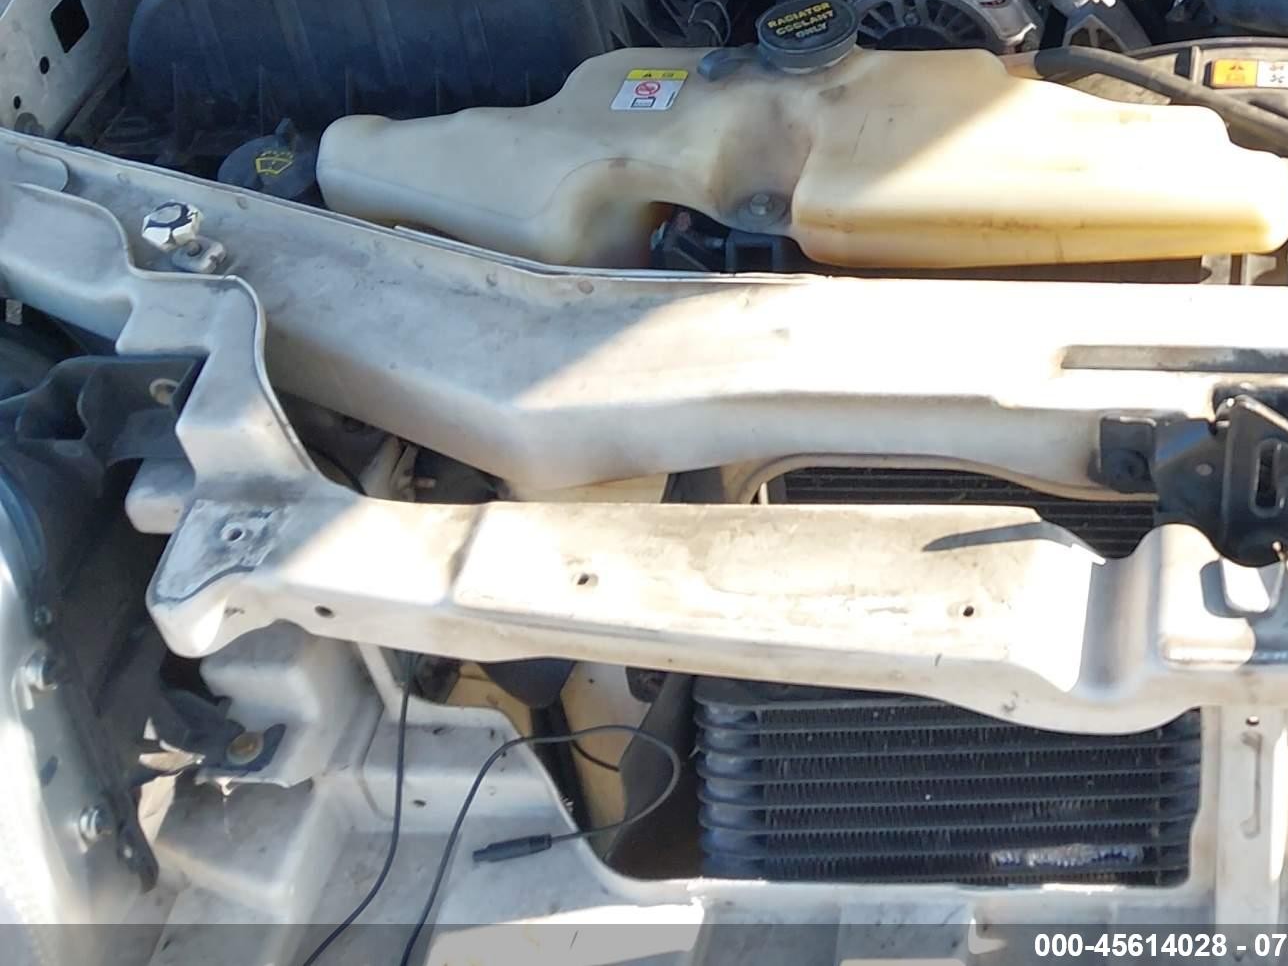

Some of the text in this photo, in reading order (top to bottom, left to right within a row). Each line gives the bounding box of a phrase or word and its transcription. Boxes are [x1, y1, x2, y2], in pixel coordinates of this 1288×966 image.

[767, 2, 831, 28] RADIATOR
[775, 10, 833, 36] COOLANT
[794, 22, 828, 39] ONLY
